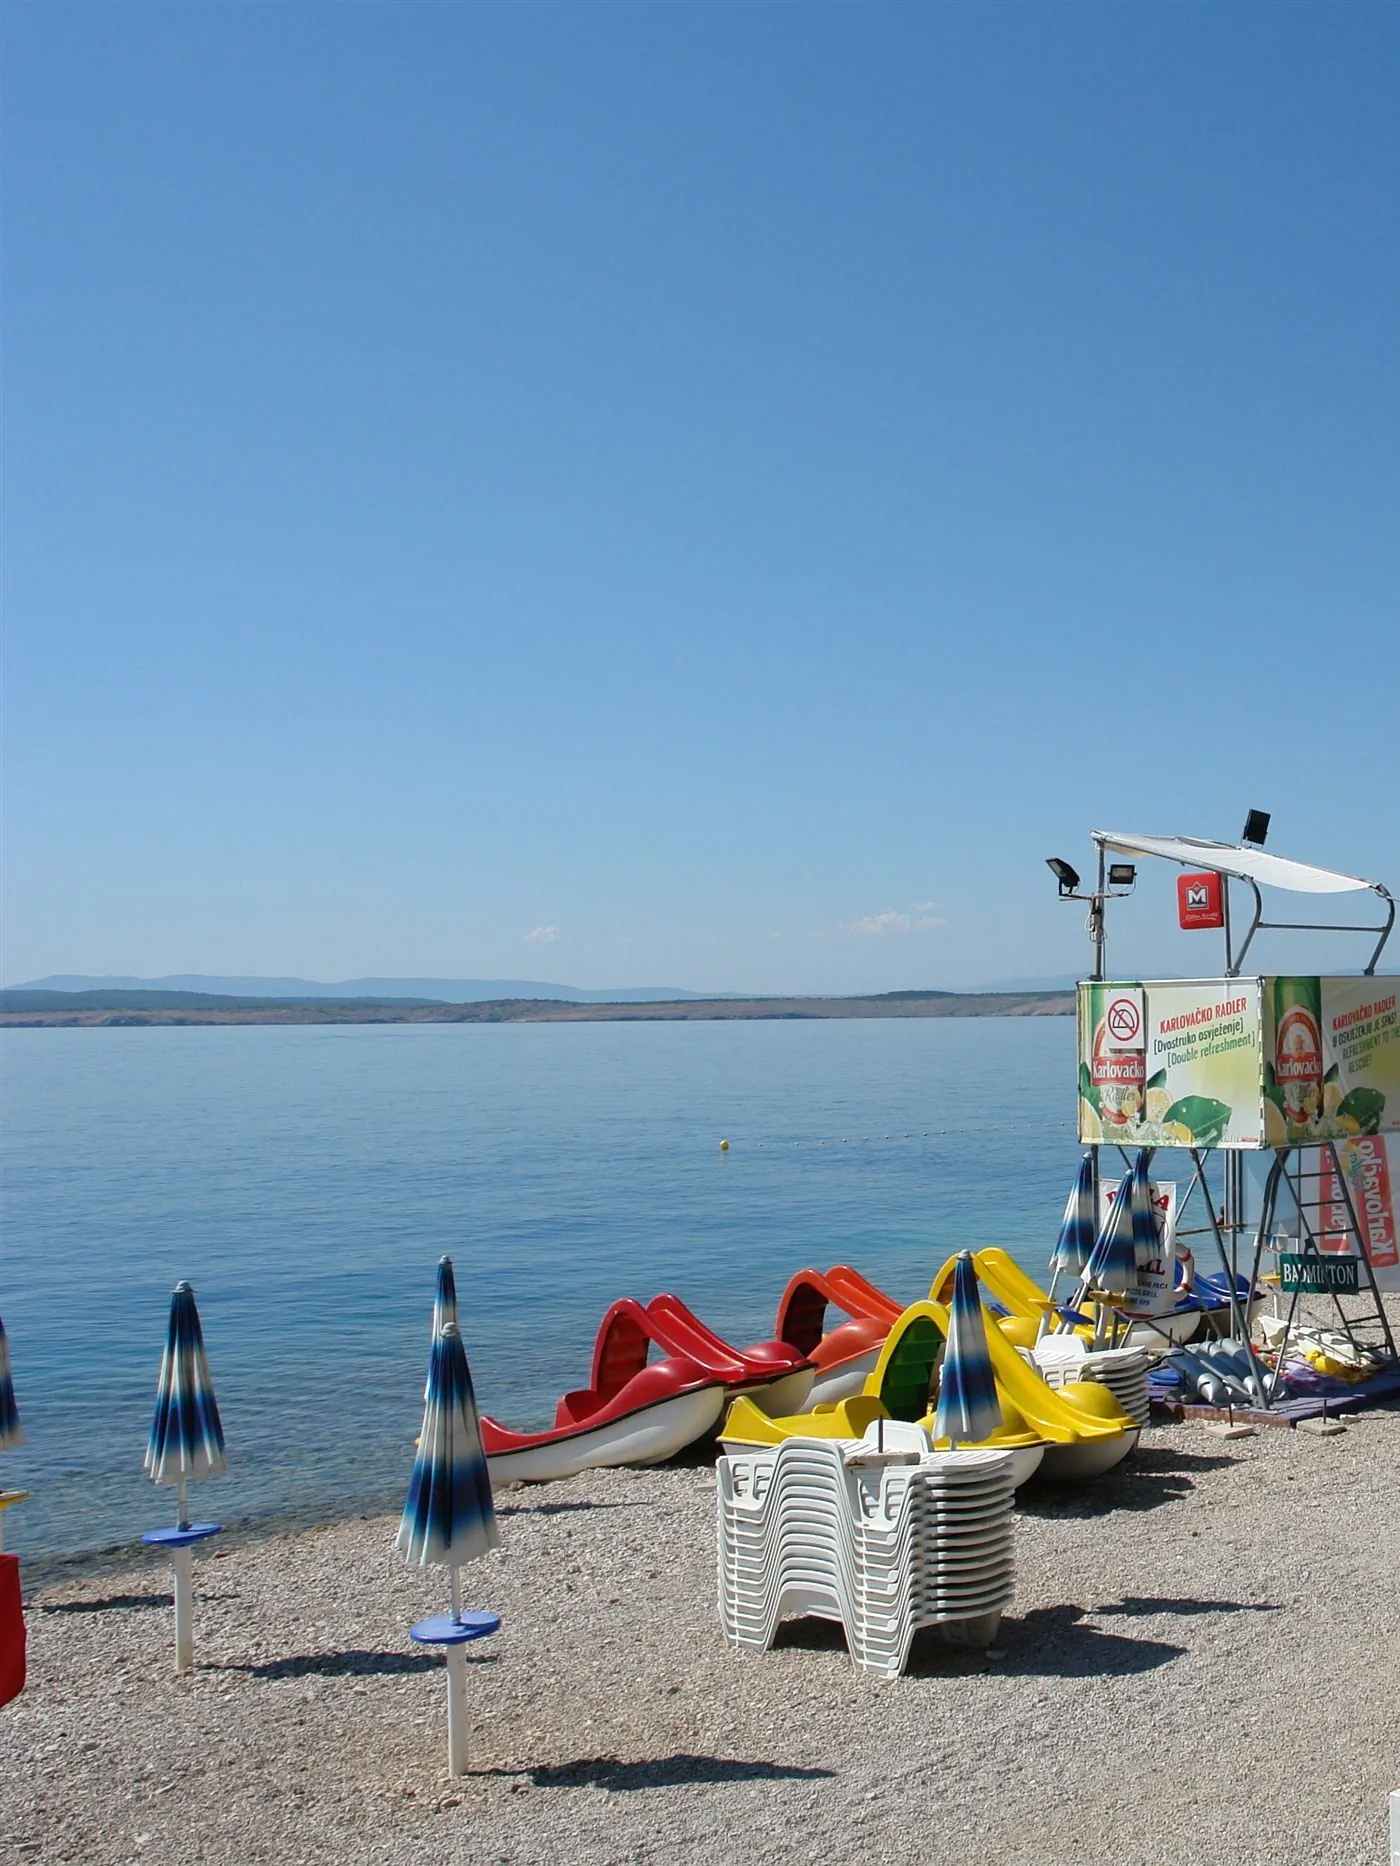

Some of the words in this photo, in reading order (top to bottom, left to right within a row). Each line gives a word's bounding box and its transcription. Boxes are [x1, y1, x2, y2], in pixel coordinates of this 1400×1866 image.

[1160, 1007, 1213, 1034] KARLOVAČKO
[1215, 997, 1247, 1018] RADLER
[1154, 1031, 1197, 1056] [Dvostruko
[1167, 1047, 1199, 1068] [Double
[1200, 1031, 1255, 1058] refreshment]
[1092, 1060, 1145, 1078] Karlovačko
